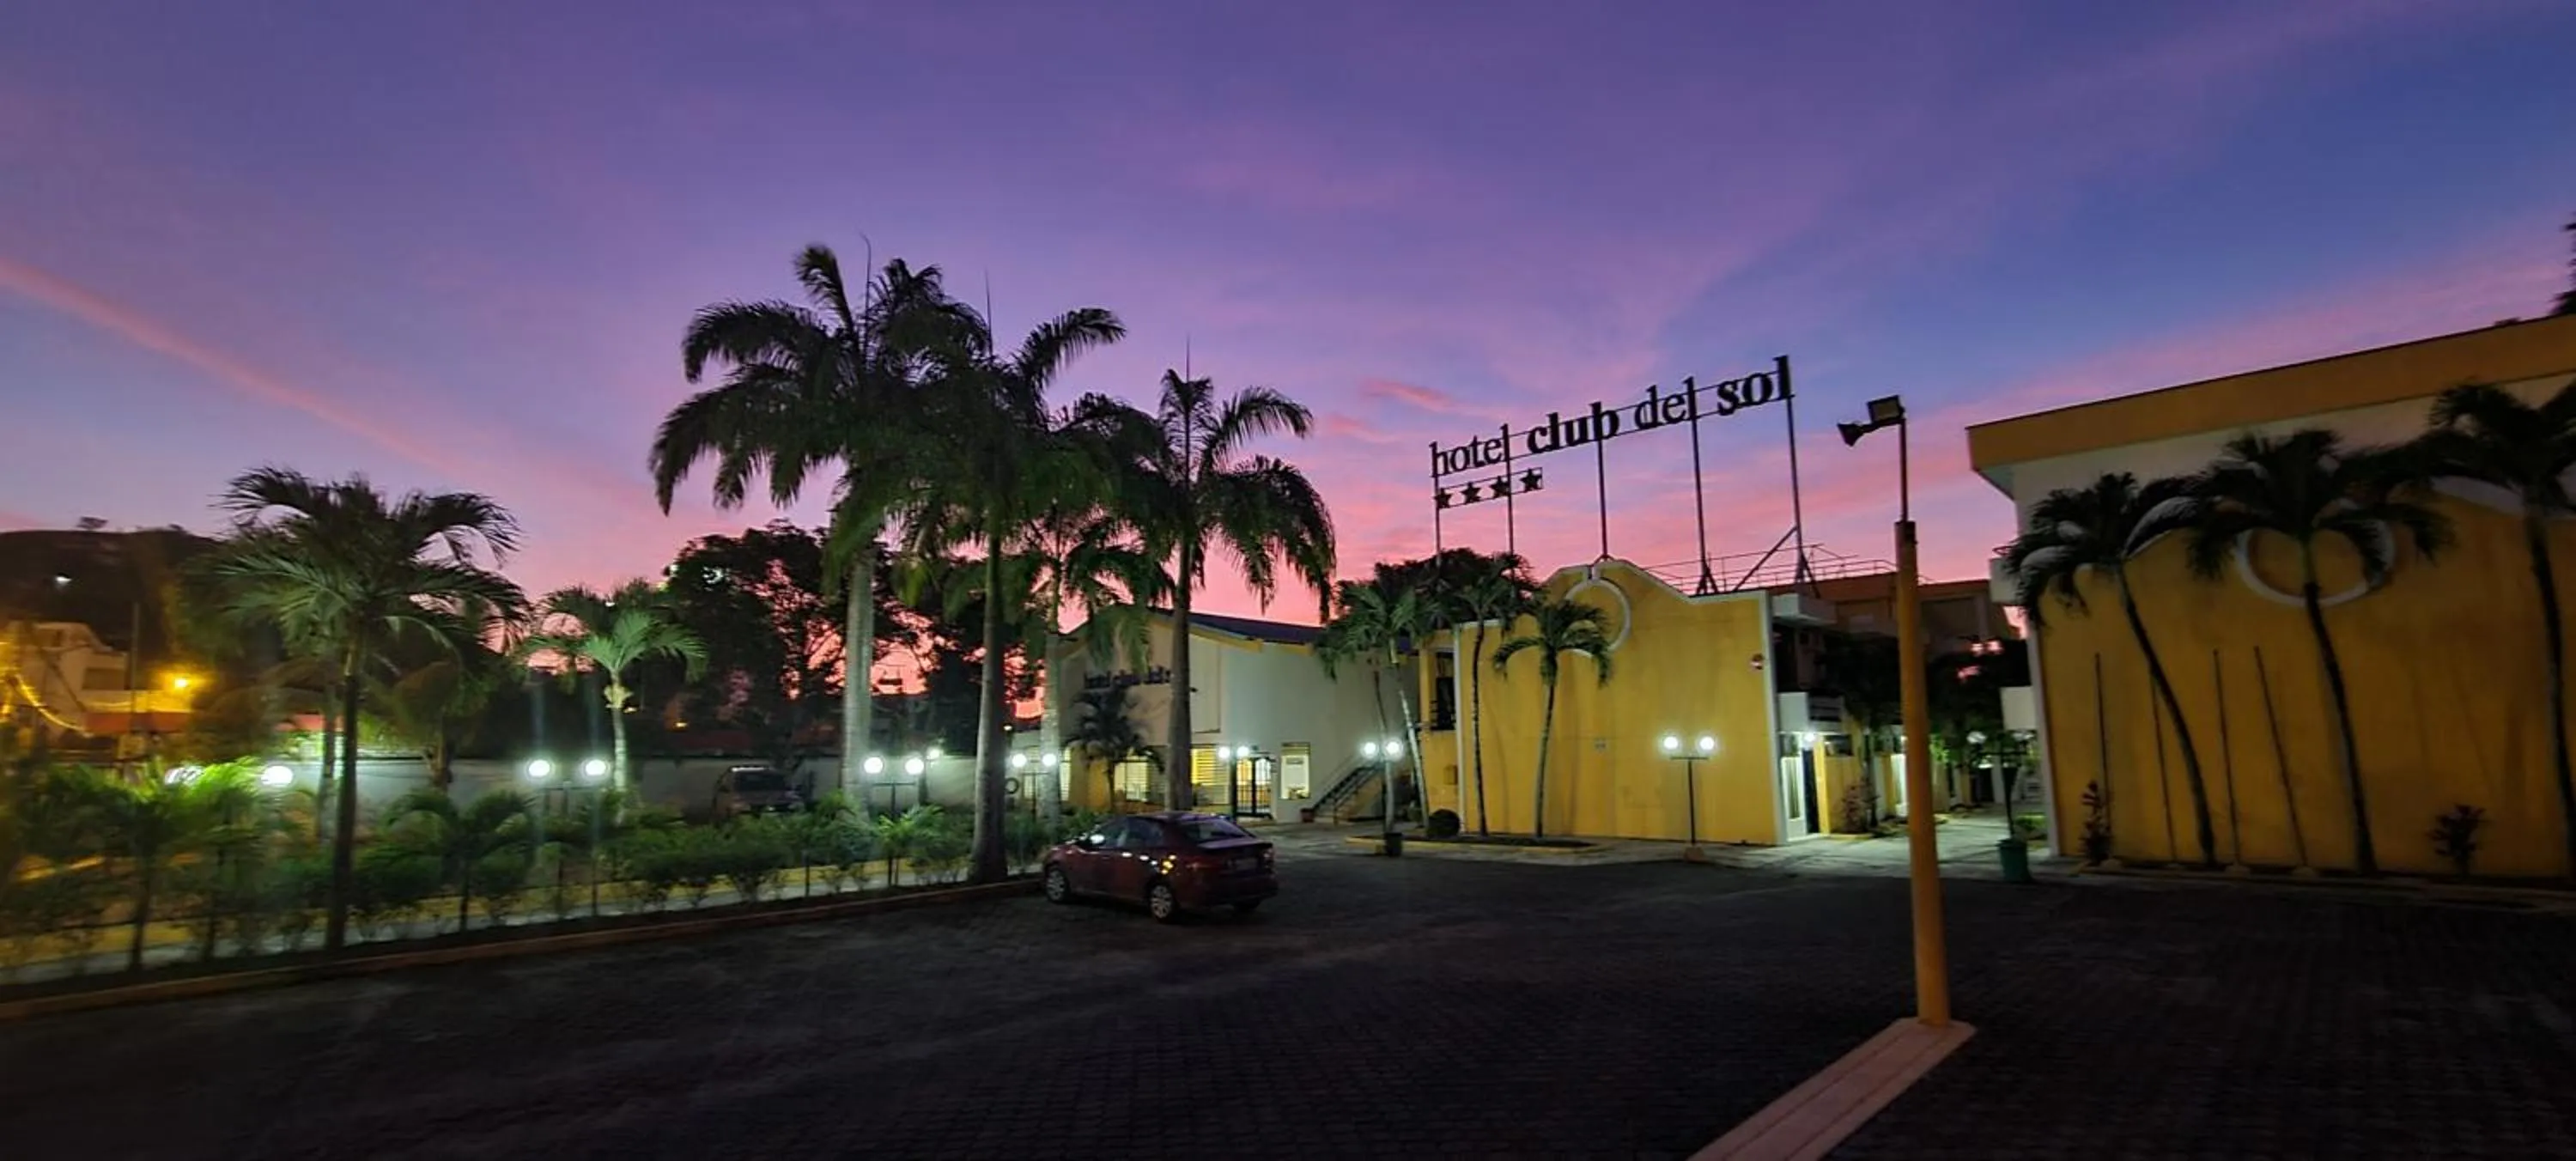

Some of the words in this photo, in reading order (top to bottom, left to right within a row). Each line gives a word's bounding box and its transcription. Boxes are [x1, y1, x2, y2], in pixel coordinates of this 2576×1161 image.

[1429, 424, 1510, 477] hotel
[1527, 401, 1620, 454] club
[1634, 376, 1699, 429] del
[1717, 356, 1793, 416] sol
